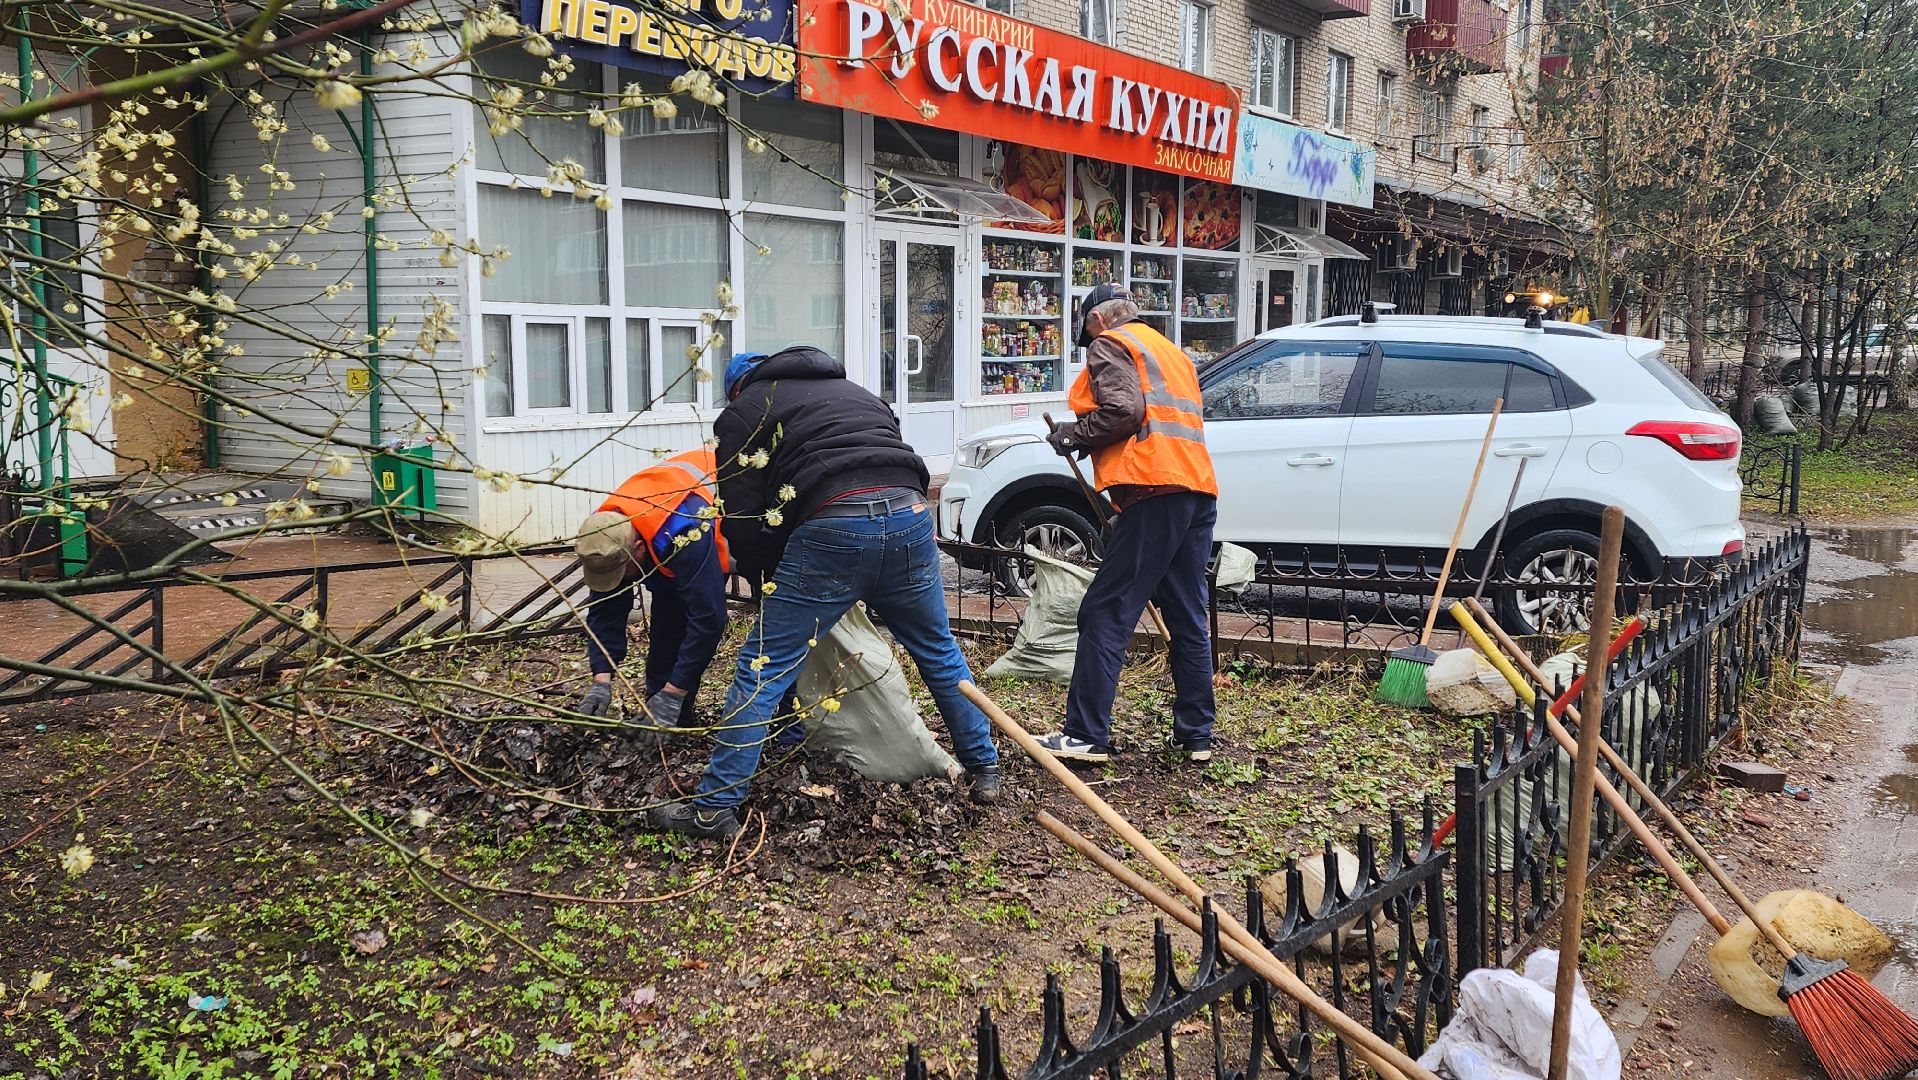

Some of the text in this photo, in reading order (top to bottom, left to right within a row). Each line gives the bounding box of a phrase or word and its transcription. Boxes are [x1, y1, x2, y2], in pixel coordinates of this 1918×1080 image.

[545, 0, 796, 82] ПЕРЕВОДОВ
[924, 0, 1034, 51] КУЛИНАРИИ
[839, 0, 1233, 154] РУССКАЯ КУХНЯ
[1154, 143, 1232, 179] ЗАКУСОЧНАЯ
